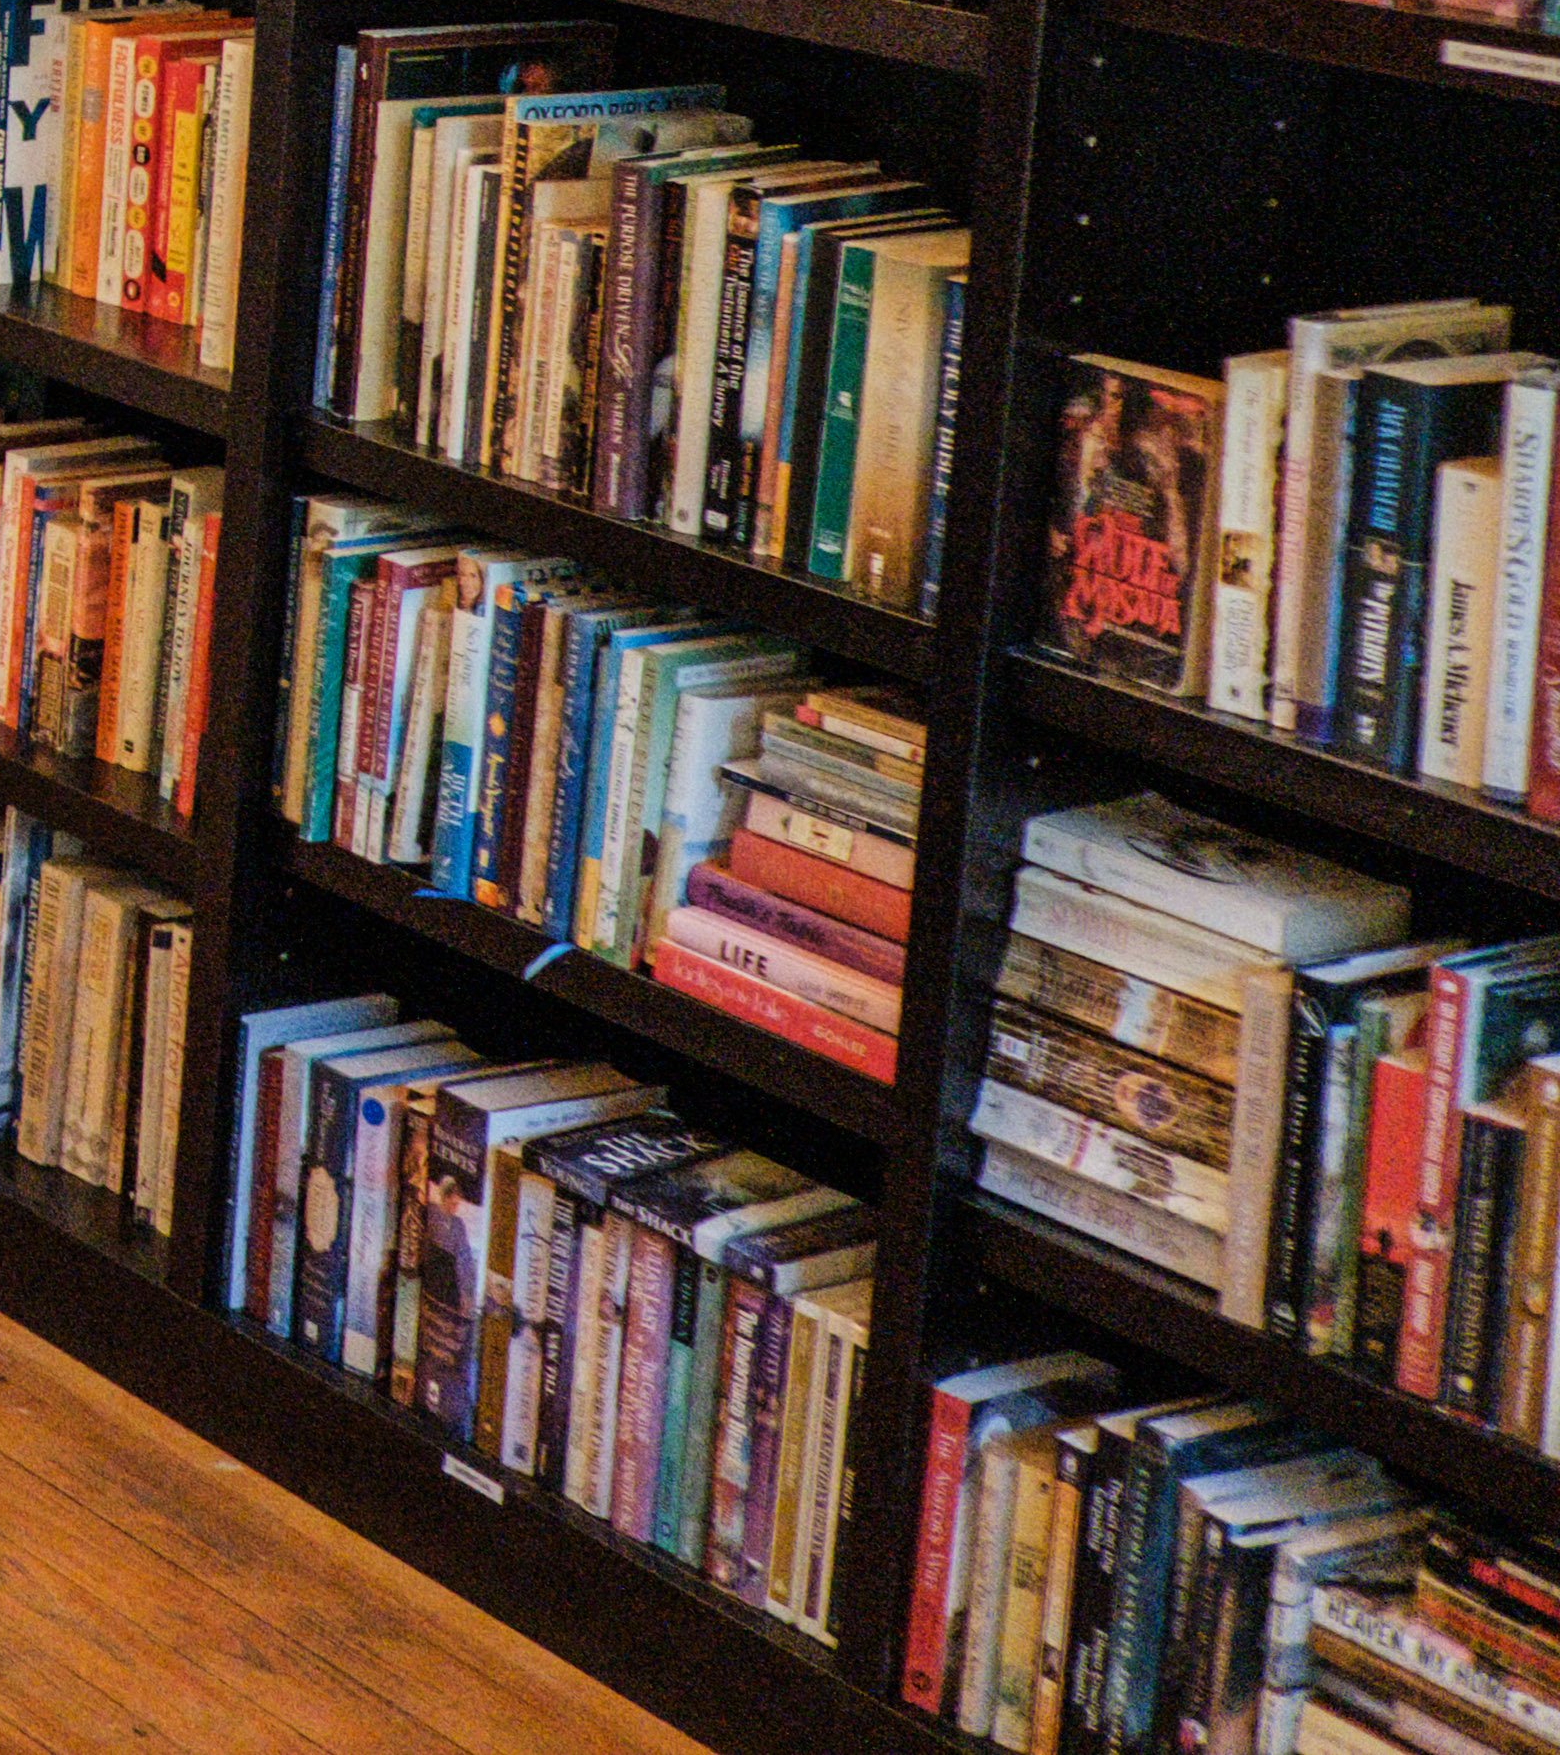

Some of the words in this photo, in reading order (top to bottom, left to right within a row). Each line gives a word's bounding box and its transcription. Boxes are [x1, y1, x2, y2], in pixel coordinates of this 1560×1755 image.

[109, 44, 131, 146] FACTFULNESS
[223, 72, 234, 103] THE
[217, 108, 232, 185] EMOTION
[624, 174, 639, 198] THE
[213, 195, 226, 239] CODE
[617, 203, 637, 270] PURPOSE
[724, 243, 741, 273] Old
[735, 247, 753, 276] The
[615, 275, 633, 337] DRIVEN
[732, 279, 752, 341] Essence
[731, 344, 745, 361] of
[947, 319, 964, 348] THE
[717, 361, 731, 374] A
[728, 365, 745, 390] the
[942, 352, 963, 424] HOLY
[610, 391, 628, 444] WARREN
[709, 378, 729, 429] Survey
[932, 427, 956, 497] BIBLE
[176, 535, 194, 619] JOURNEY
[1505, 558, 1533, 631] GOLD
[1447, 578, 1477, 638] James
[369, 604, 387, 676] MINUTES
[385, 610, 401, 681] MINUTES
[1357, 599, 1390, 684] PATRIOTS
[169, 654, 182, 687] JOY
[1439, 661, 1466, 746] Michener
[359, 705, 377, 776] HEAVEN
[375, 708, 392, 776] HEAVEN
[437, 761, 454, 826] MOORE
[450, 772, 467, 826] BETH
[607, 802, 622, 845] SINGLE
[720, 940, 768, 978] LIFE
[584, 1133, 718, 1174] SHACK
[613, 1127, 648, 1149] THE
[536, 1157, 592, 1191] YOUNG
[638, 1203, 696, 1246] SHACK
[545, 1292, 567, 1326] DAY
[545, 1331, 560, 1358] VAN
